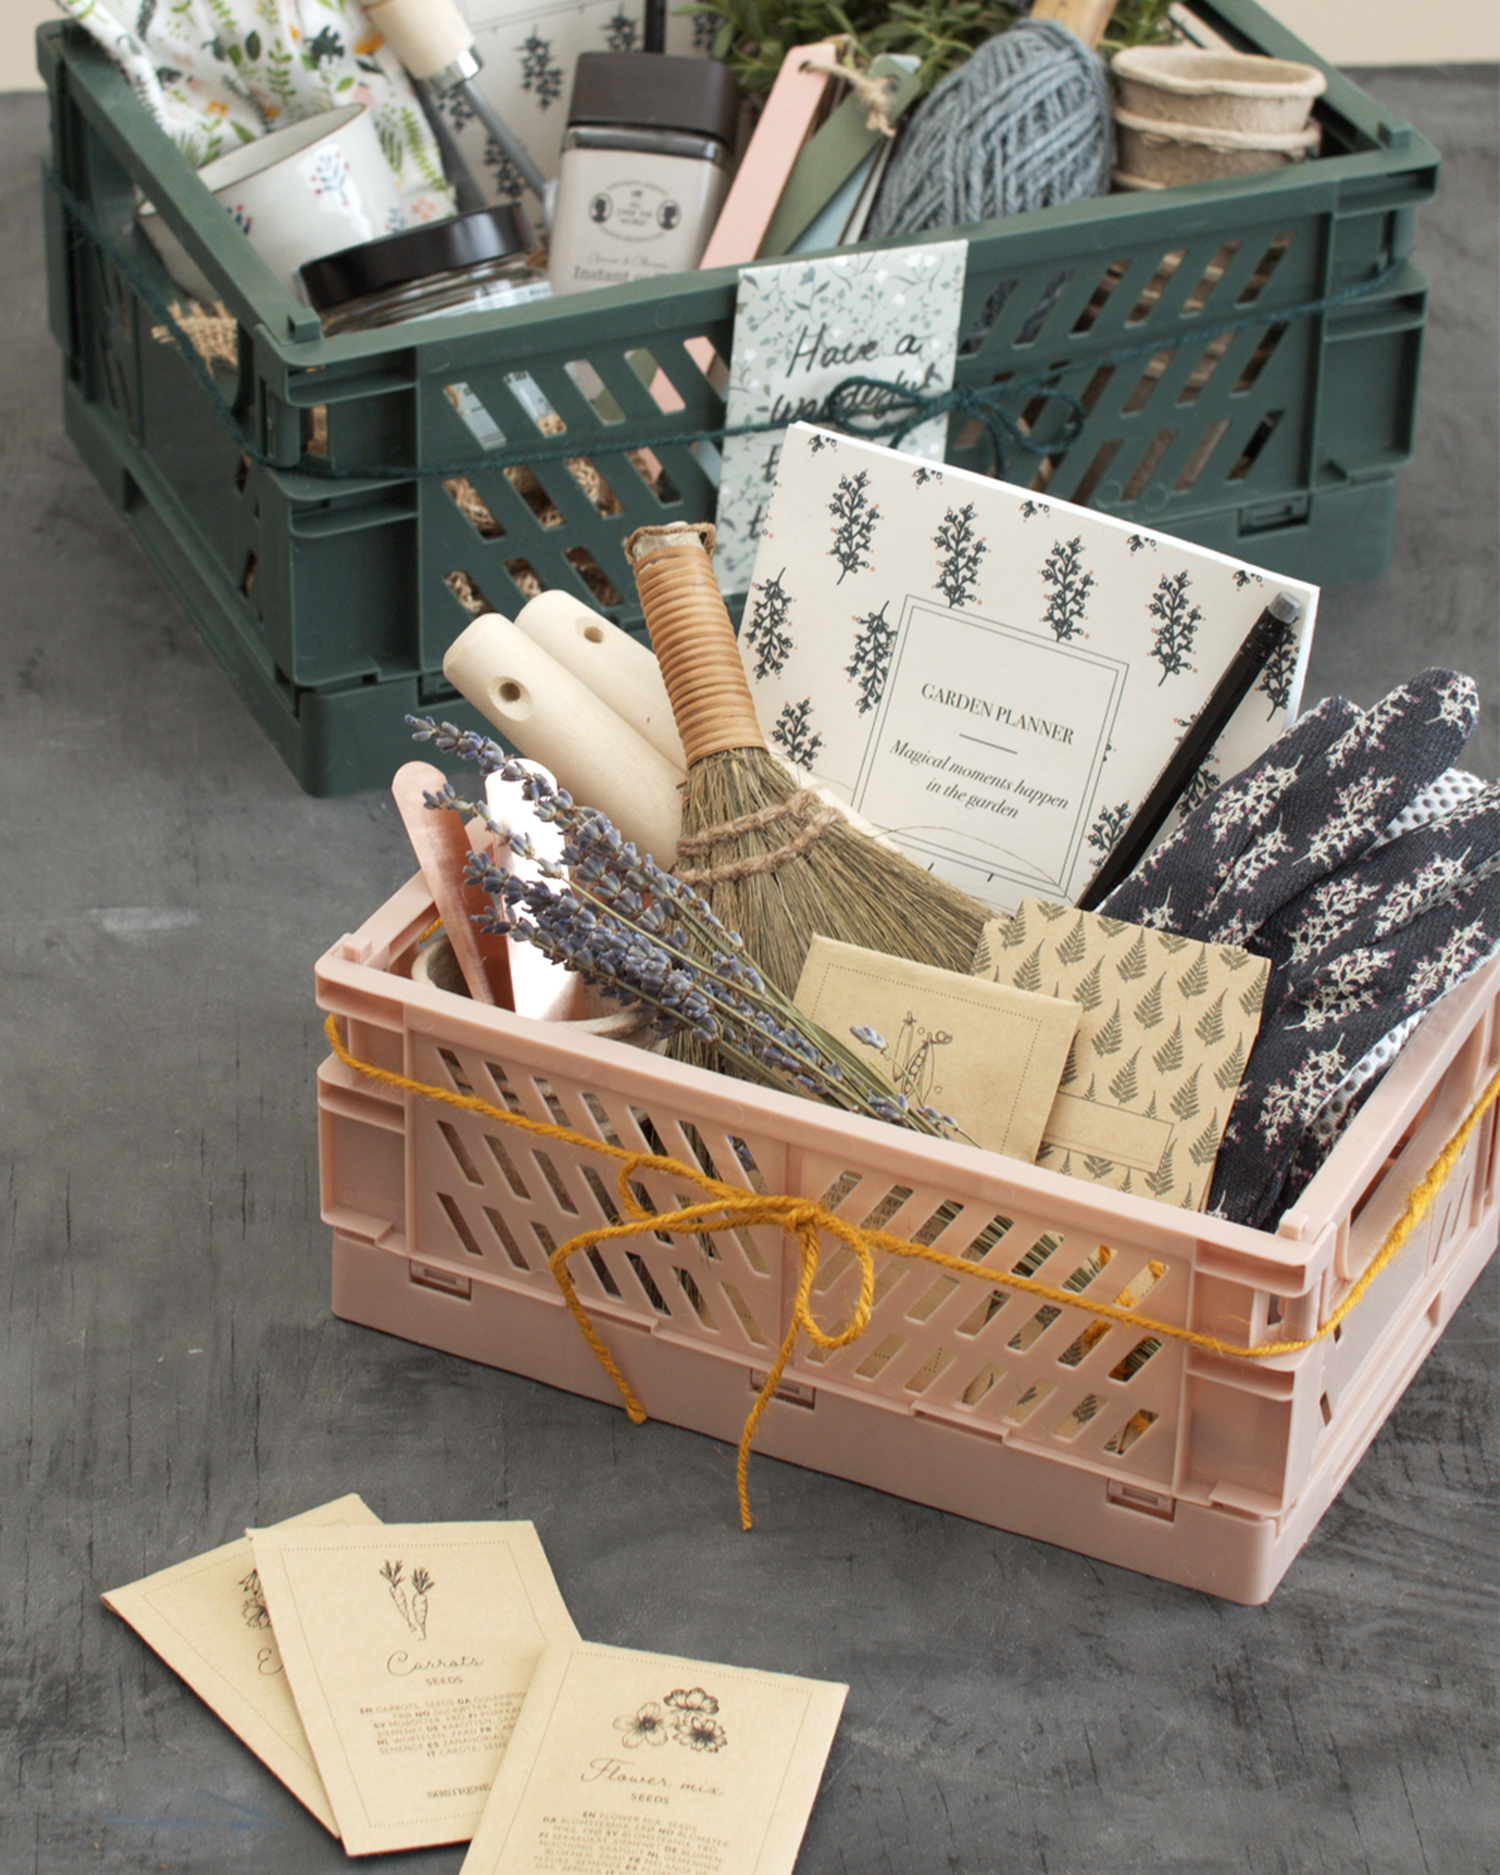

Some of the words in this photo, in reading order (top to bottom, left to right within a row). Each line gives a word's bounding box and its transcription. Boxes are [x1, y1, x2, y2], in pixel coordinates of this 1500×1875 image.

[573, 265, 630, 281] Instant
[787, 322, 878, 378] Have
[895, 334, 923, 356] a
[921, 682, 994, 718] GARDEN
[995, 706, 1075, 745] PLANNER
[889, 739, 951, 770] Magical
[949, 761, 1014, 791] moments
[1013, 778, 1070, 810] happen
[925, 777, 941, 794] in
[942, 782, 966, 801] the
[965, 791, 1020, 819] garden
[387, 1650, 484, 1677] Carrots
[425, 1676, 463, 1686] SEEDS
[425, 1699, 454, 1709] SEEDS
[580, 1757, 672, 1787] Flower
[680, 1779, 724, 1796] mix
[630, 1792, 670, 1805] SEEDS
[542, 1815, 556, 1823] DA
[658, 1827, 674, 1835] NO
[582, 1810, 597, 1819] EN
[599, 1811, 640, 1822] FLOWER
[668, 1820, 698, 1832] SEEDS
[664, 1845, 677, 1853] DE
